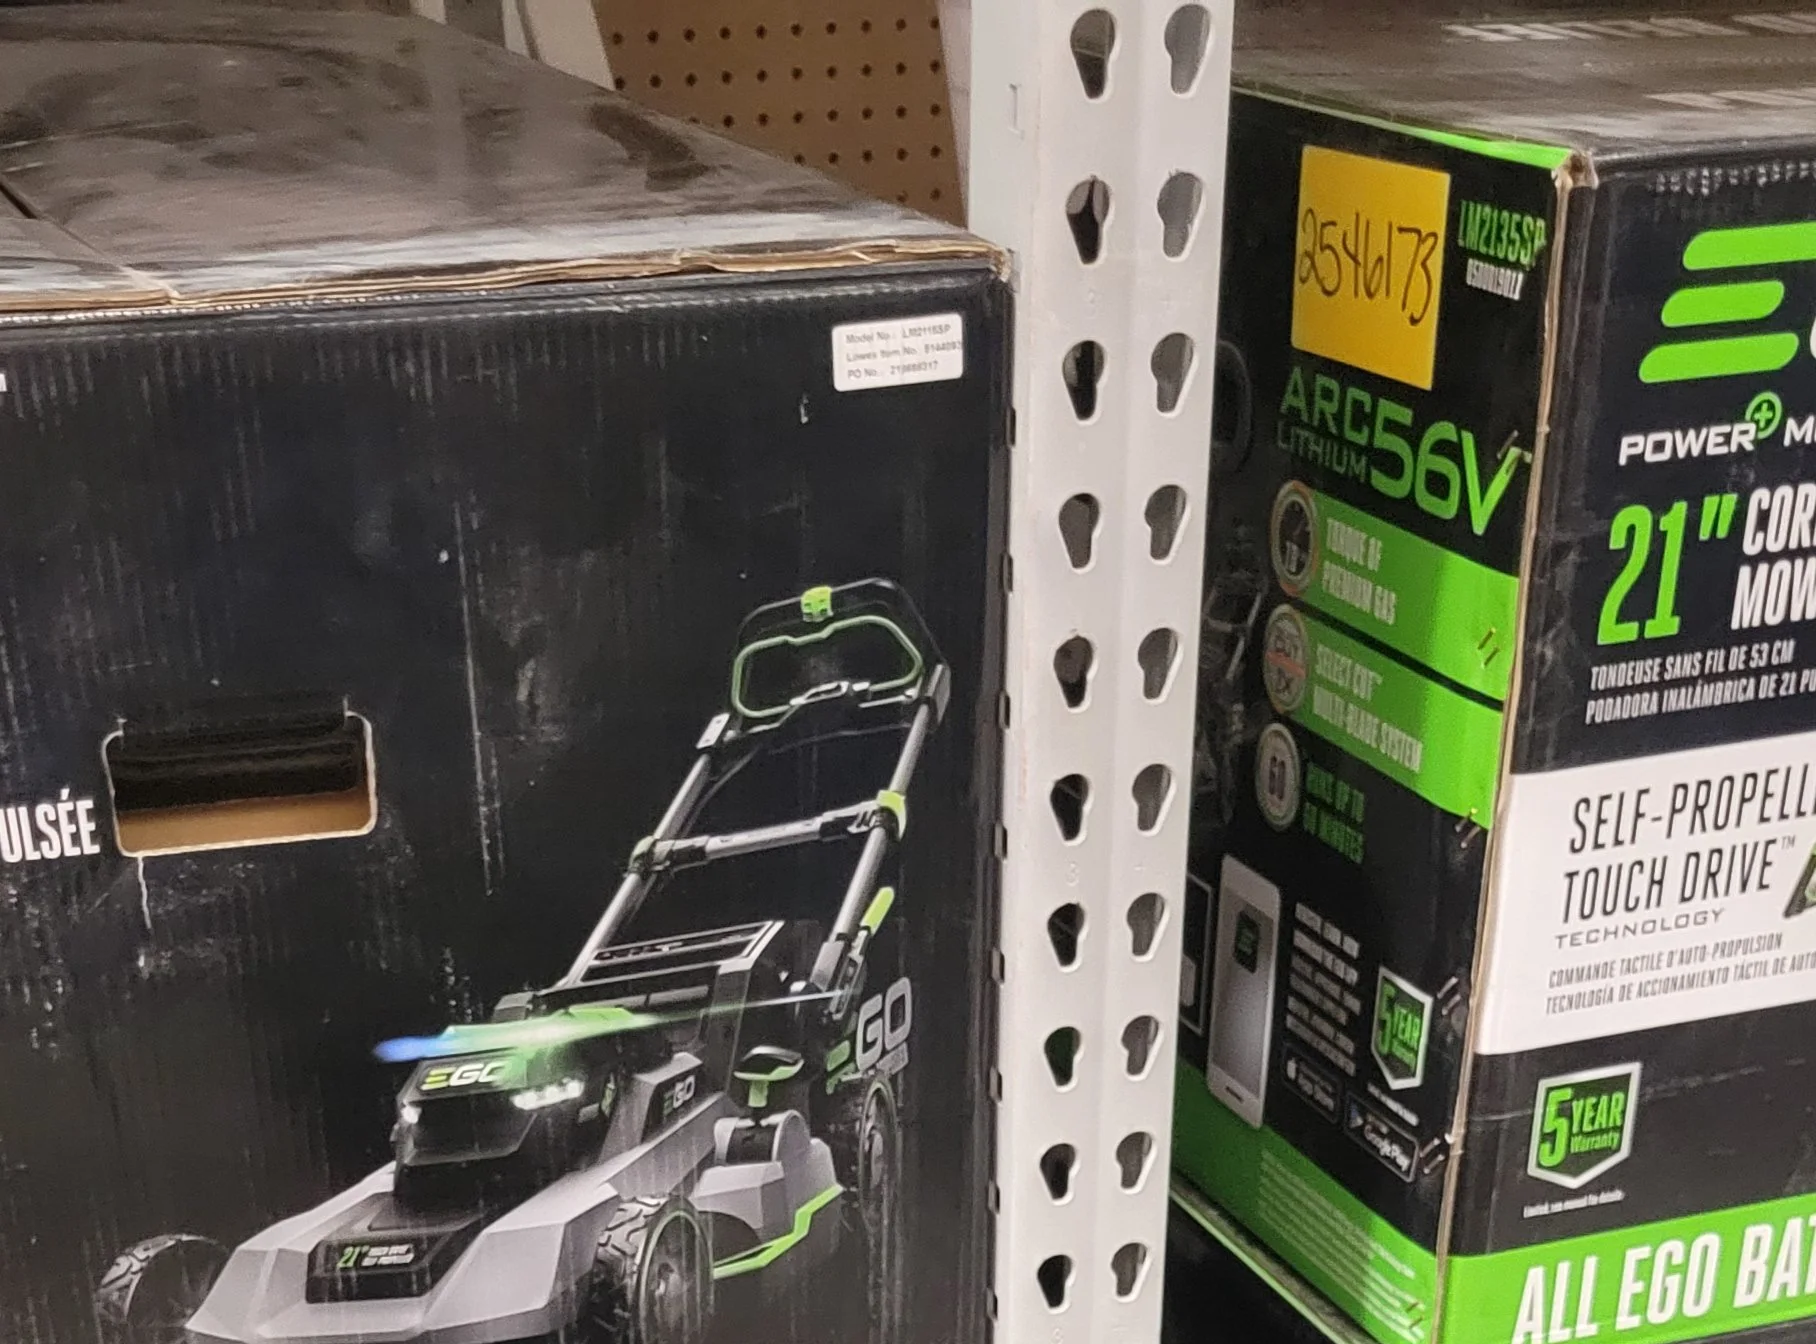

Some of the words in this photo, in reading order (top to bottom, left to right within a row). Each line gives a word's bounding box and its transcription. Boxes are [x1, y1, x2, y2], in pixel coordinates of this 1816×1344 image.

[1300, 208, 1439, 325] 2546173
[1276, 419, 1368, 483] LITHIUM
[1618, 421, 1757, 466] POWER
[1743, 482, 1816, 556] COR
[1590, 657, 1662, 691] TONDEUSE
[1663, 651, 1702, 680] SANS
[1704, 648, 1726, 674] FIL
[1728, 645, 1747, 672] DE
[1749, 642, 1769, 670] 53
[1770, 638, 1796, 666] CM
[1585, 691, 1658, 725] PODADORA
[1661, 675, 1755, 713] INALÁMBRICA
[1758, 675, 1776, 699] DE
[1778, 671, 1797, 696] 21
[1569, 762, 1816, 855] SELF-PROPELL
[1563, 855, 1668, 925] TOUCH
[1554, 908, 1725, 950] TECHNOLOGY
[1545, 984, 1615, 1016] TECNOLOGÍA
[1618, 982, 1633, 1002] DE
[1636, 965, 1730, 999] ACCIONAMIENTO
[1733, 960, 1769, 984] TÁCTIL
[1771, 957, 1786, 976] DE
[1549, 960, 1616, 989] COMMANDE
[1619, 951, 1663, 976] TACTILE
[1538, 1087, 1574, 1168] 5
[1571, 1091, 1626, 1135] YEAR
[1615, 1232, 1721, 1331] EGO
